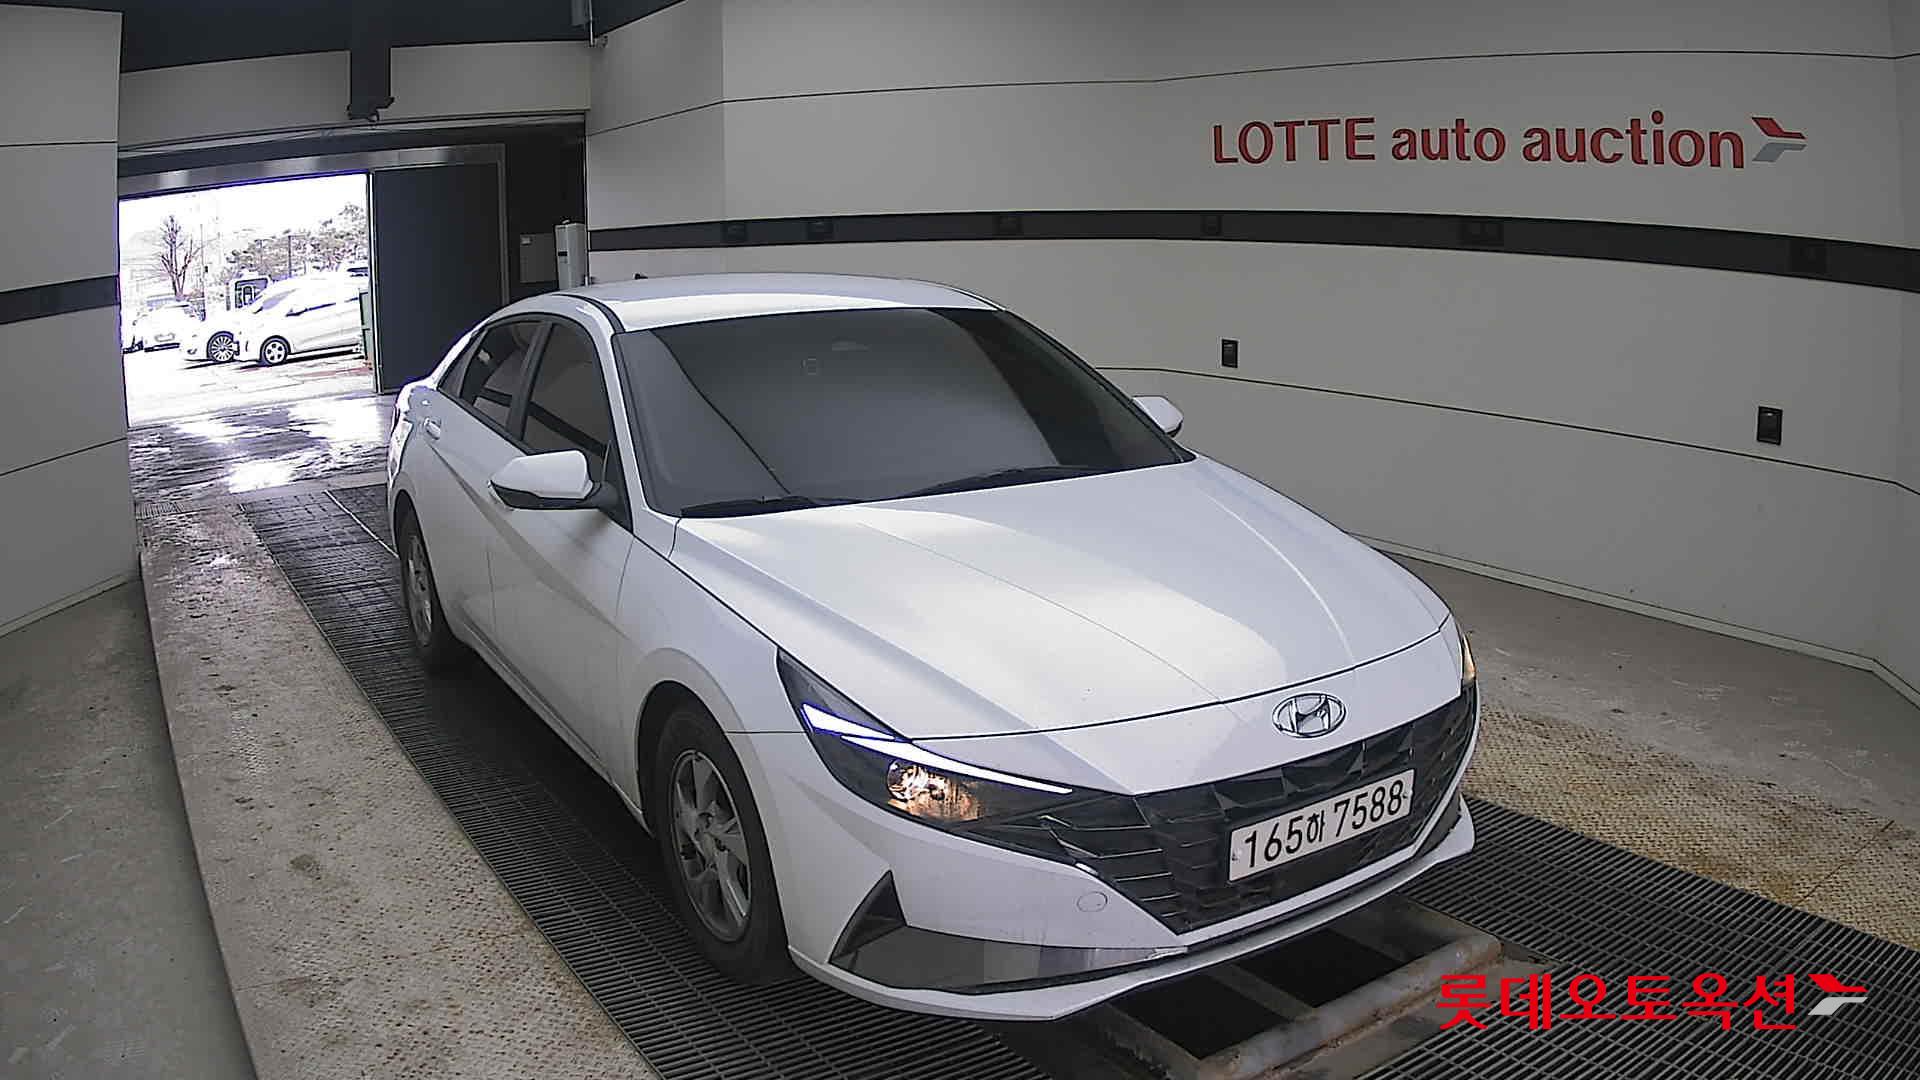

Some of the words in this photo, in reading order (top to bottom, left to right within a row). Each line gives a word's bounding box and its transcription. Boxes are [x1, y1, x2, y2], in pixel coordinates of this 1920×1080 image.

[1213, 117, 1375, 164] LOTTE
[1391, 118, 1506, 163] auto
[1522, 110, 1744, 169] auction
[1245, 810, 1325, 868] 165하
[1334, 780, 1404, 837] 7588
